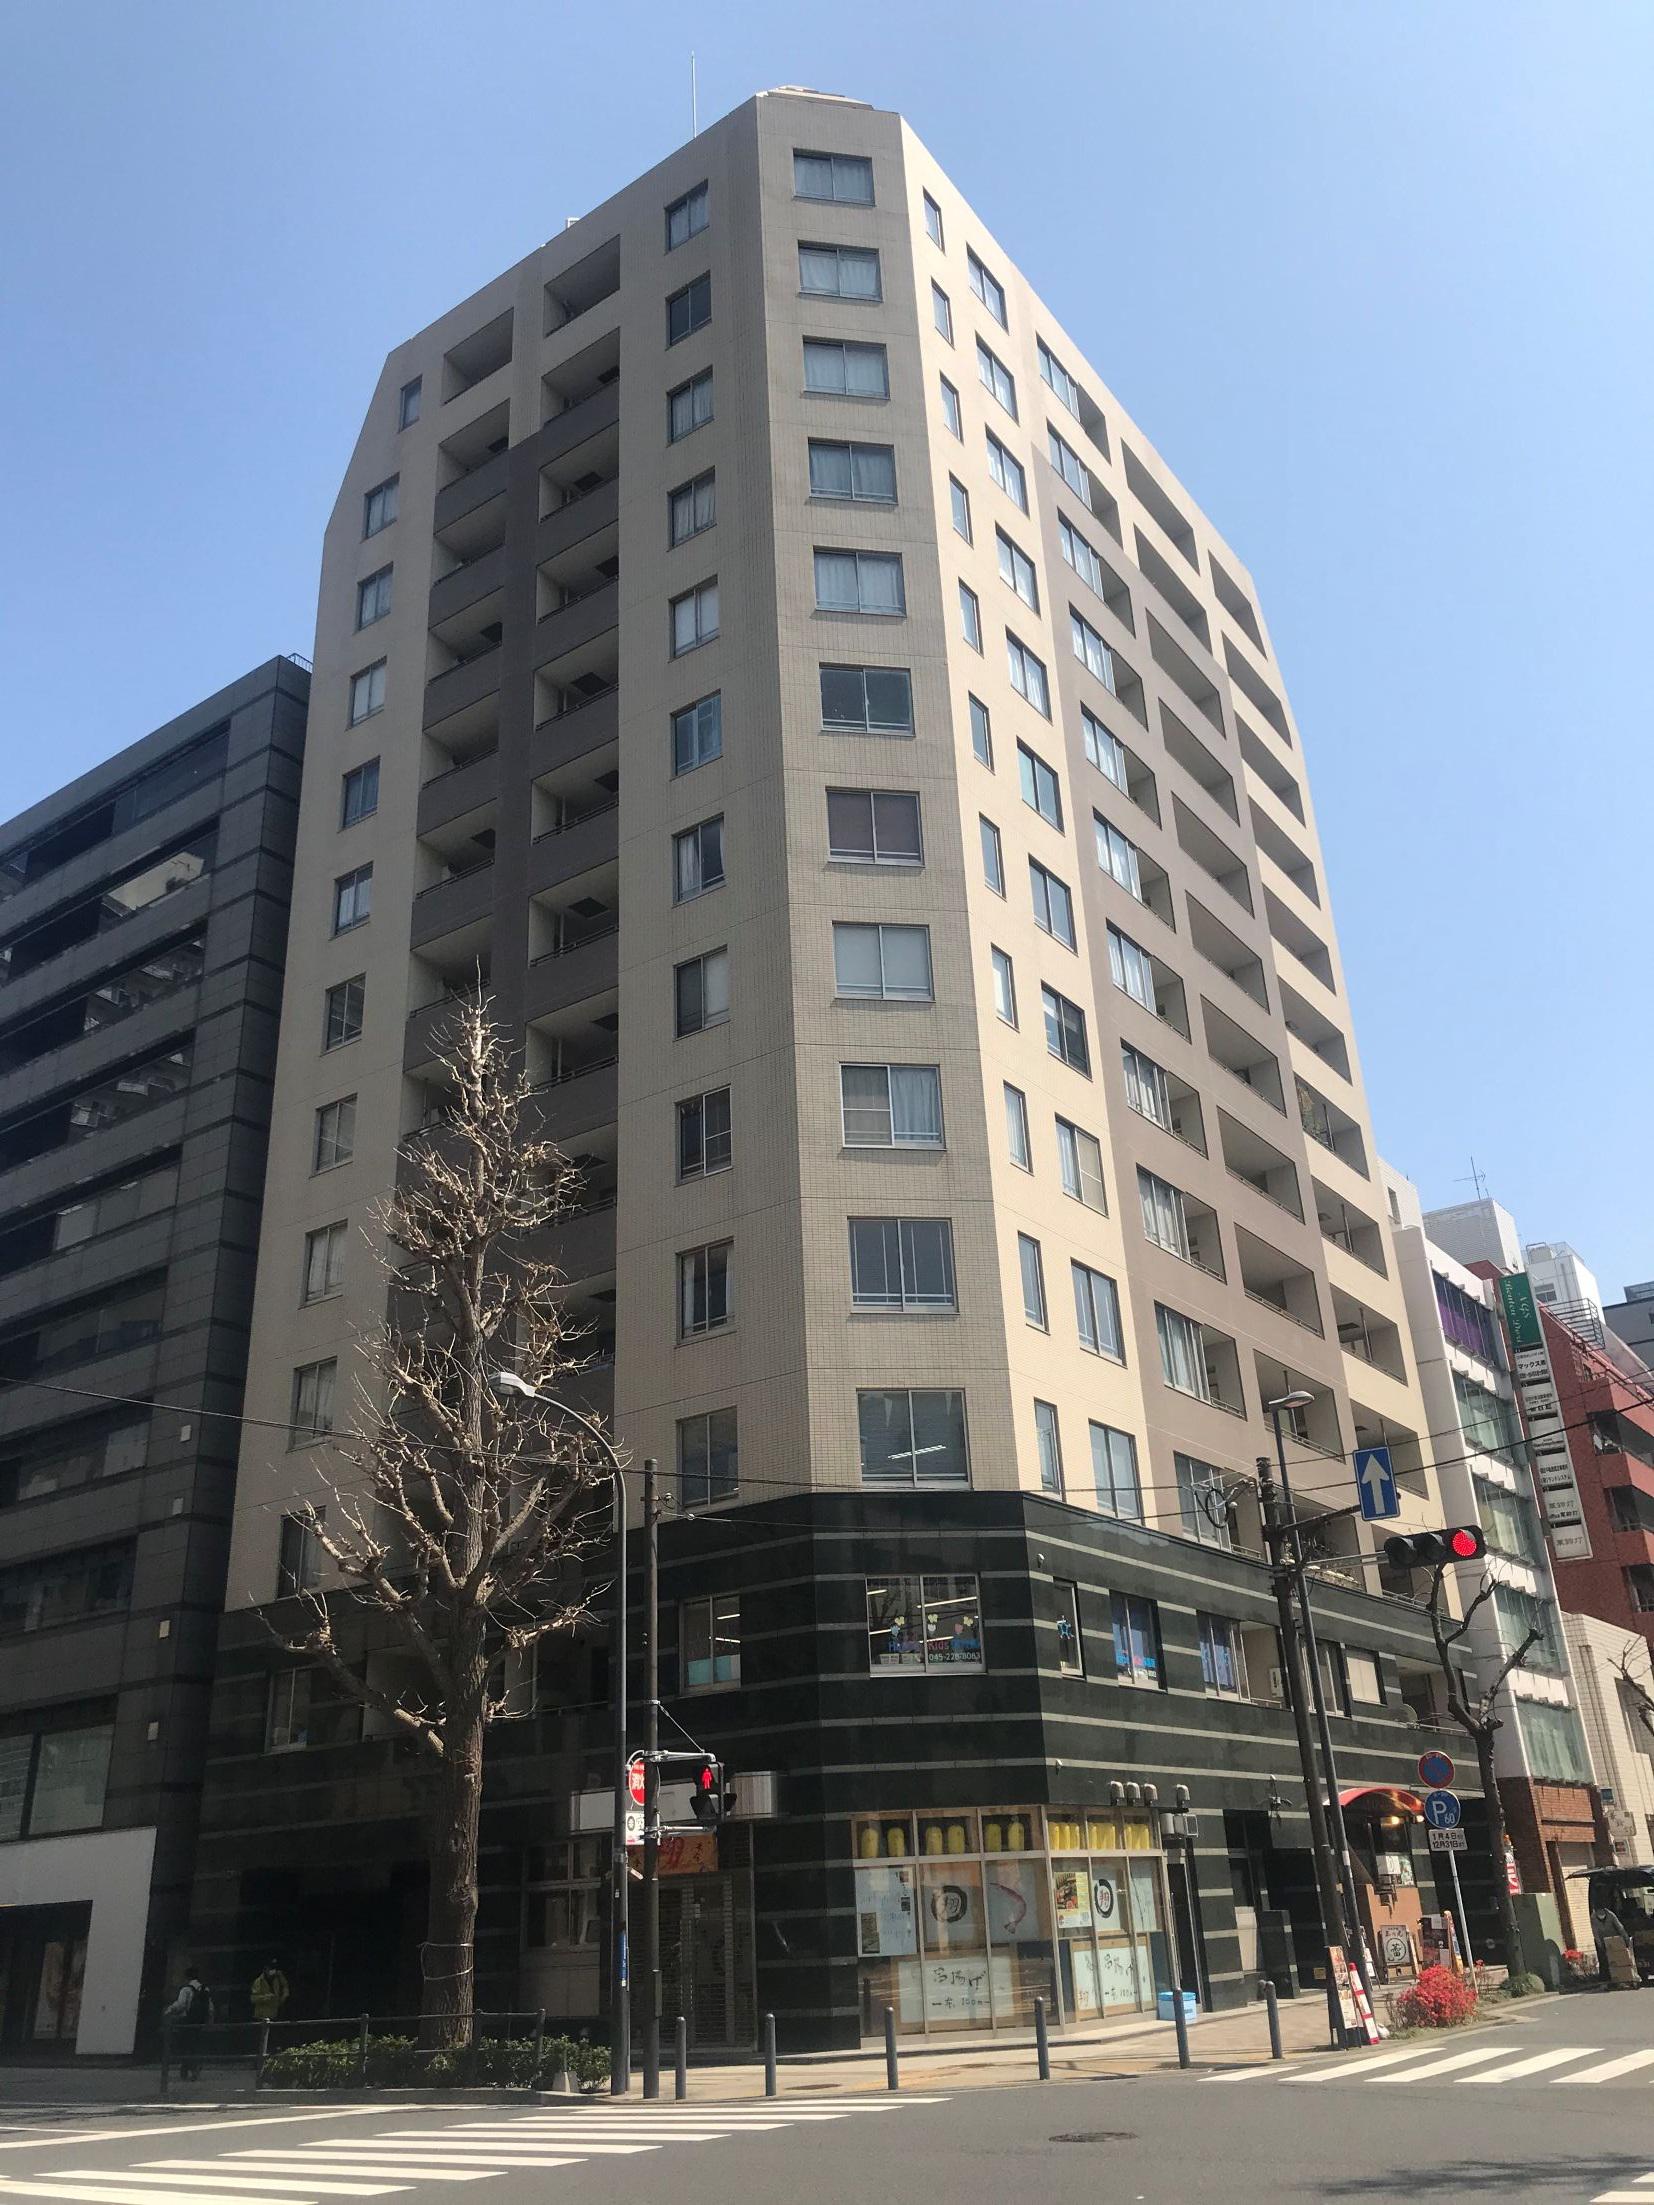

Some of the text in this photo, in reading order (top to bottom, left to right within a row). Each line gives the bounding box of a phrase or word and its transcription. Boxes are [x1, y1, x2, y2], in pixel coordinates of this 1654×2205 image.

[1432, 1801, 1447, 1825] P
[933, 1967, 986, 1990] 串揚げ
